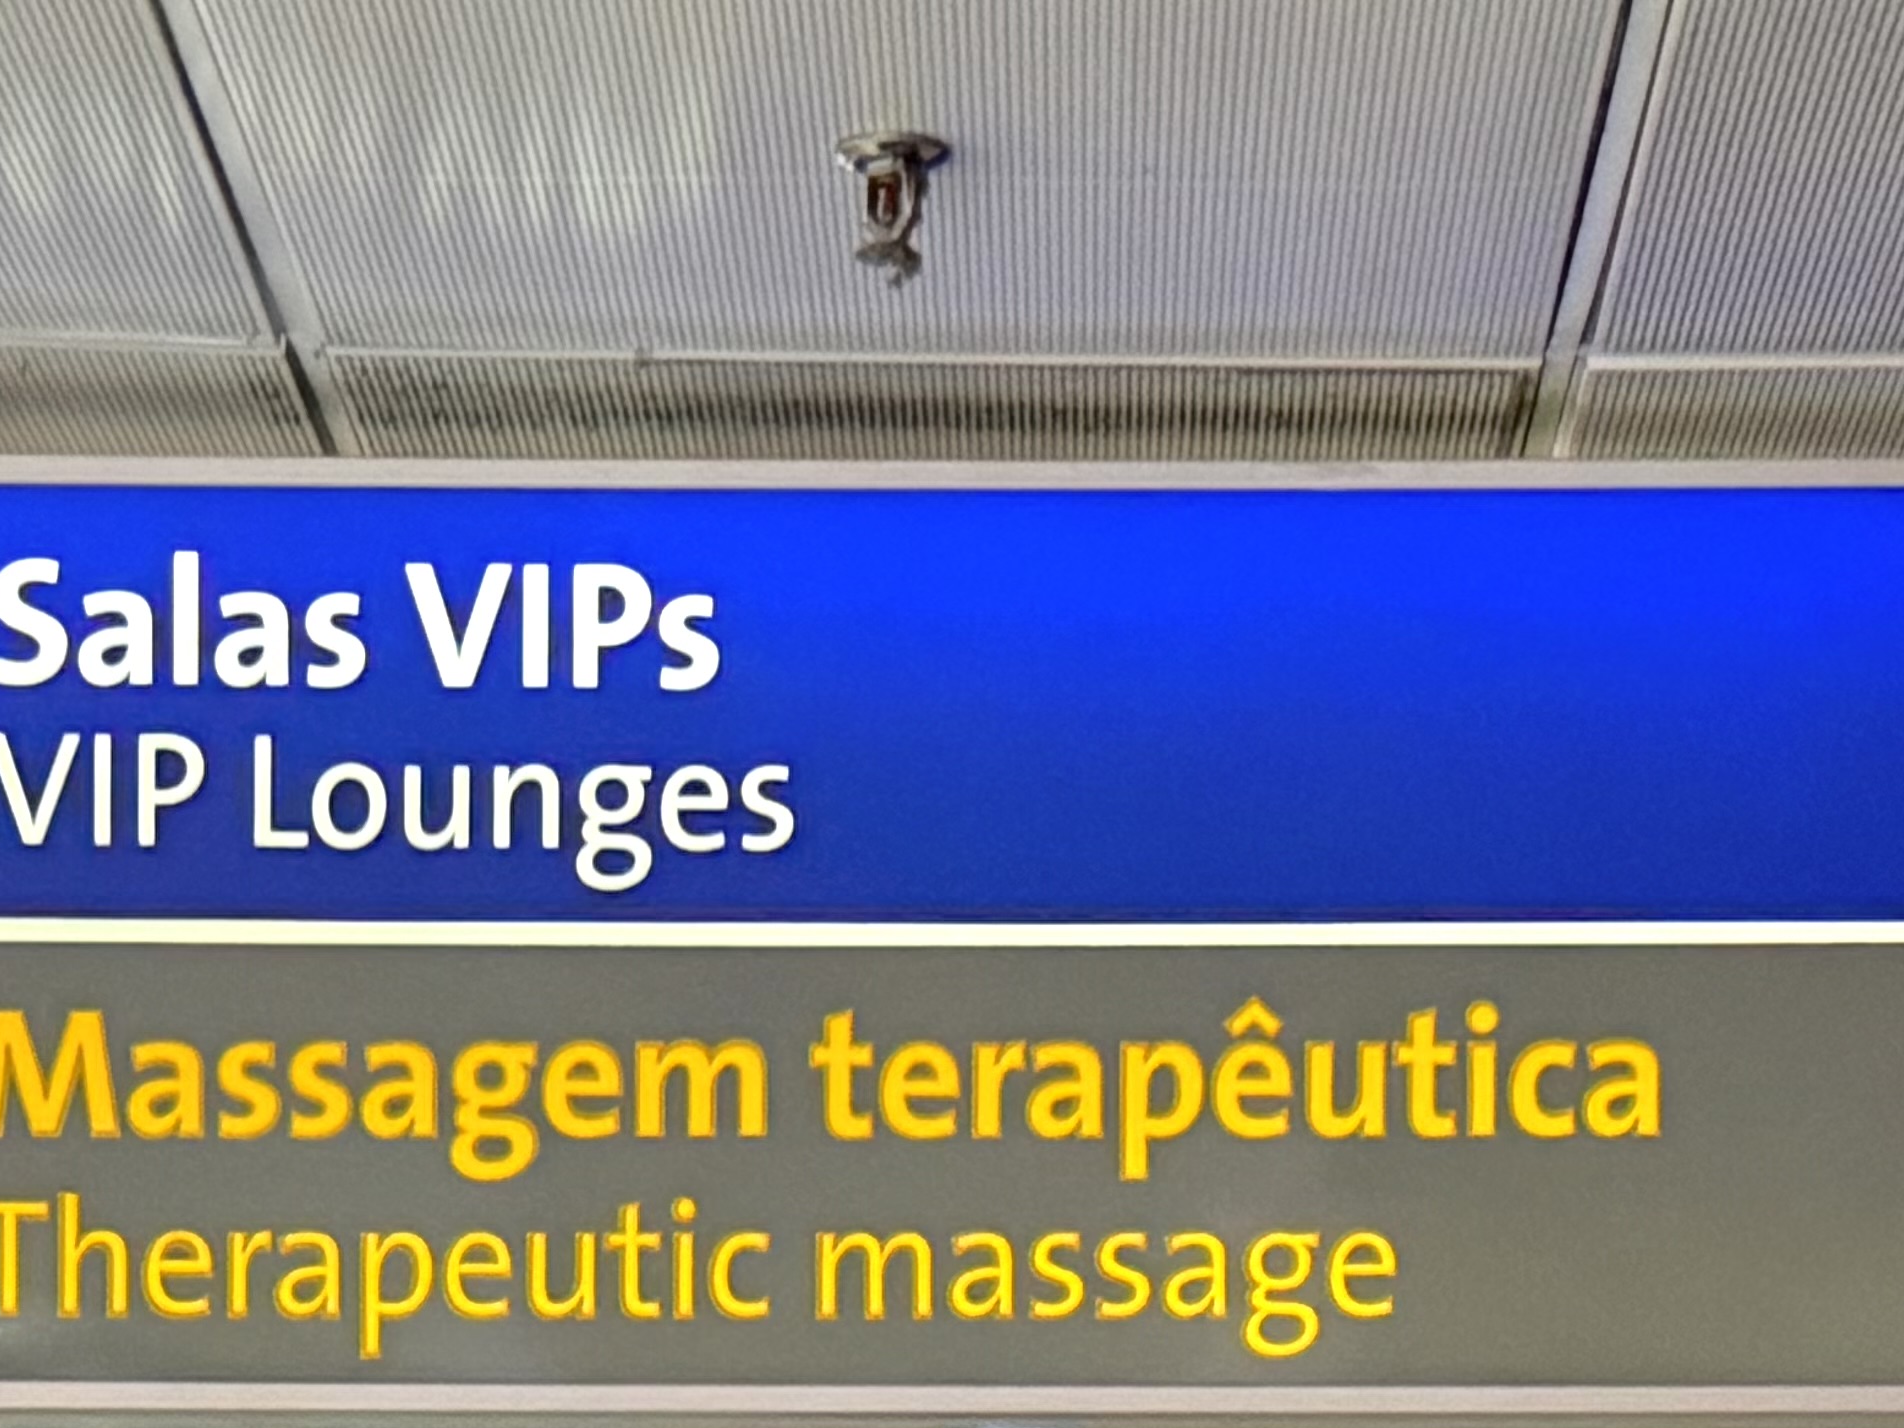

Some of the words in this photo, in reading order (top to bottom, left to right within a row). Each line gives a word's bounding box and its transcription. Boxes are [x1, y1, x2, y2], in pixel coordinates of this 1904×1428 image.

[405, 563, 719, 690] VIPs
[254, 735, 793, 890] Lounges
[810, 998, 1661, 1182] terapêutica
[816, 1230, 1398, 1359] massage
